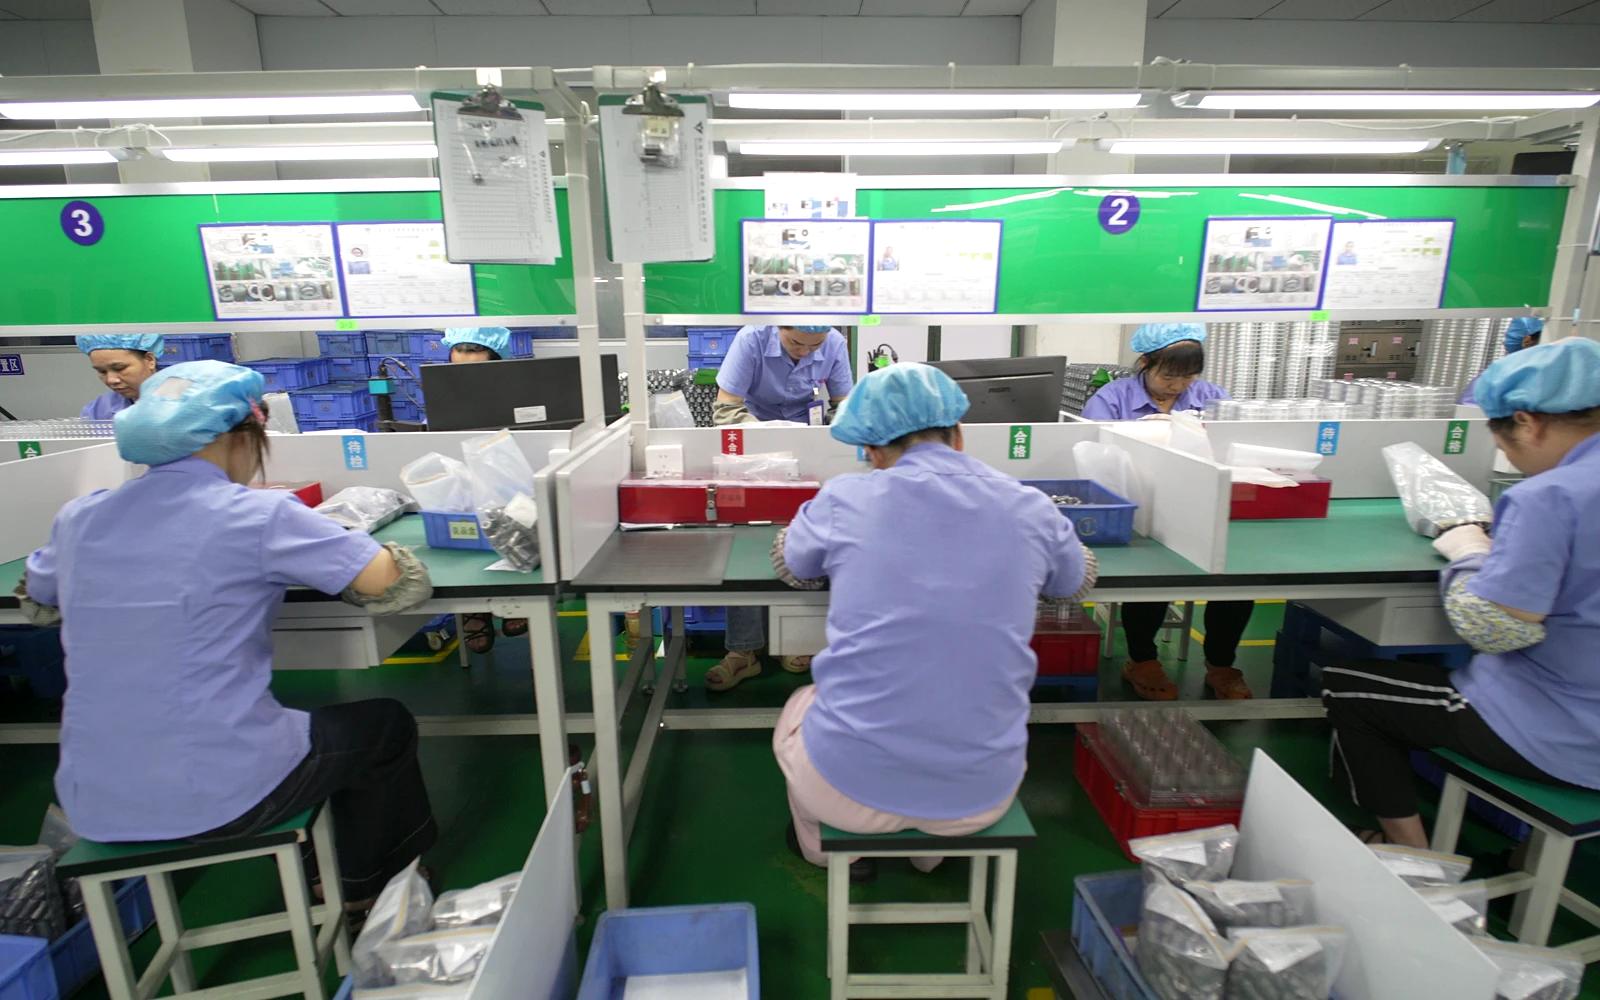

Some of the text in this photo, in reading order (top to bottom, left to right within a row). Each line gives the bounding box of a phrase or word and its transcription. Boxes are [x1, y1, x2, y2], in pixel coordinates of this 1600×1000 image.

[71, 209, 93, 237] 3
[1108, 198, 1129, 225] 2
[727, 431, 738, 455] 不合
[1012, 431, 1027, 458] 合格
